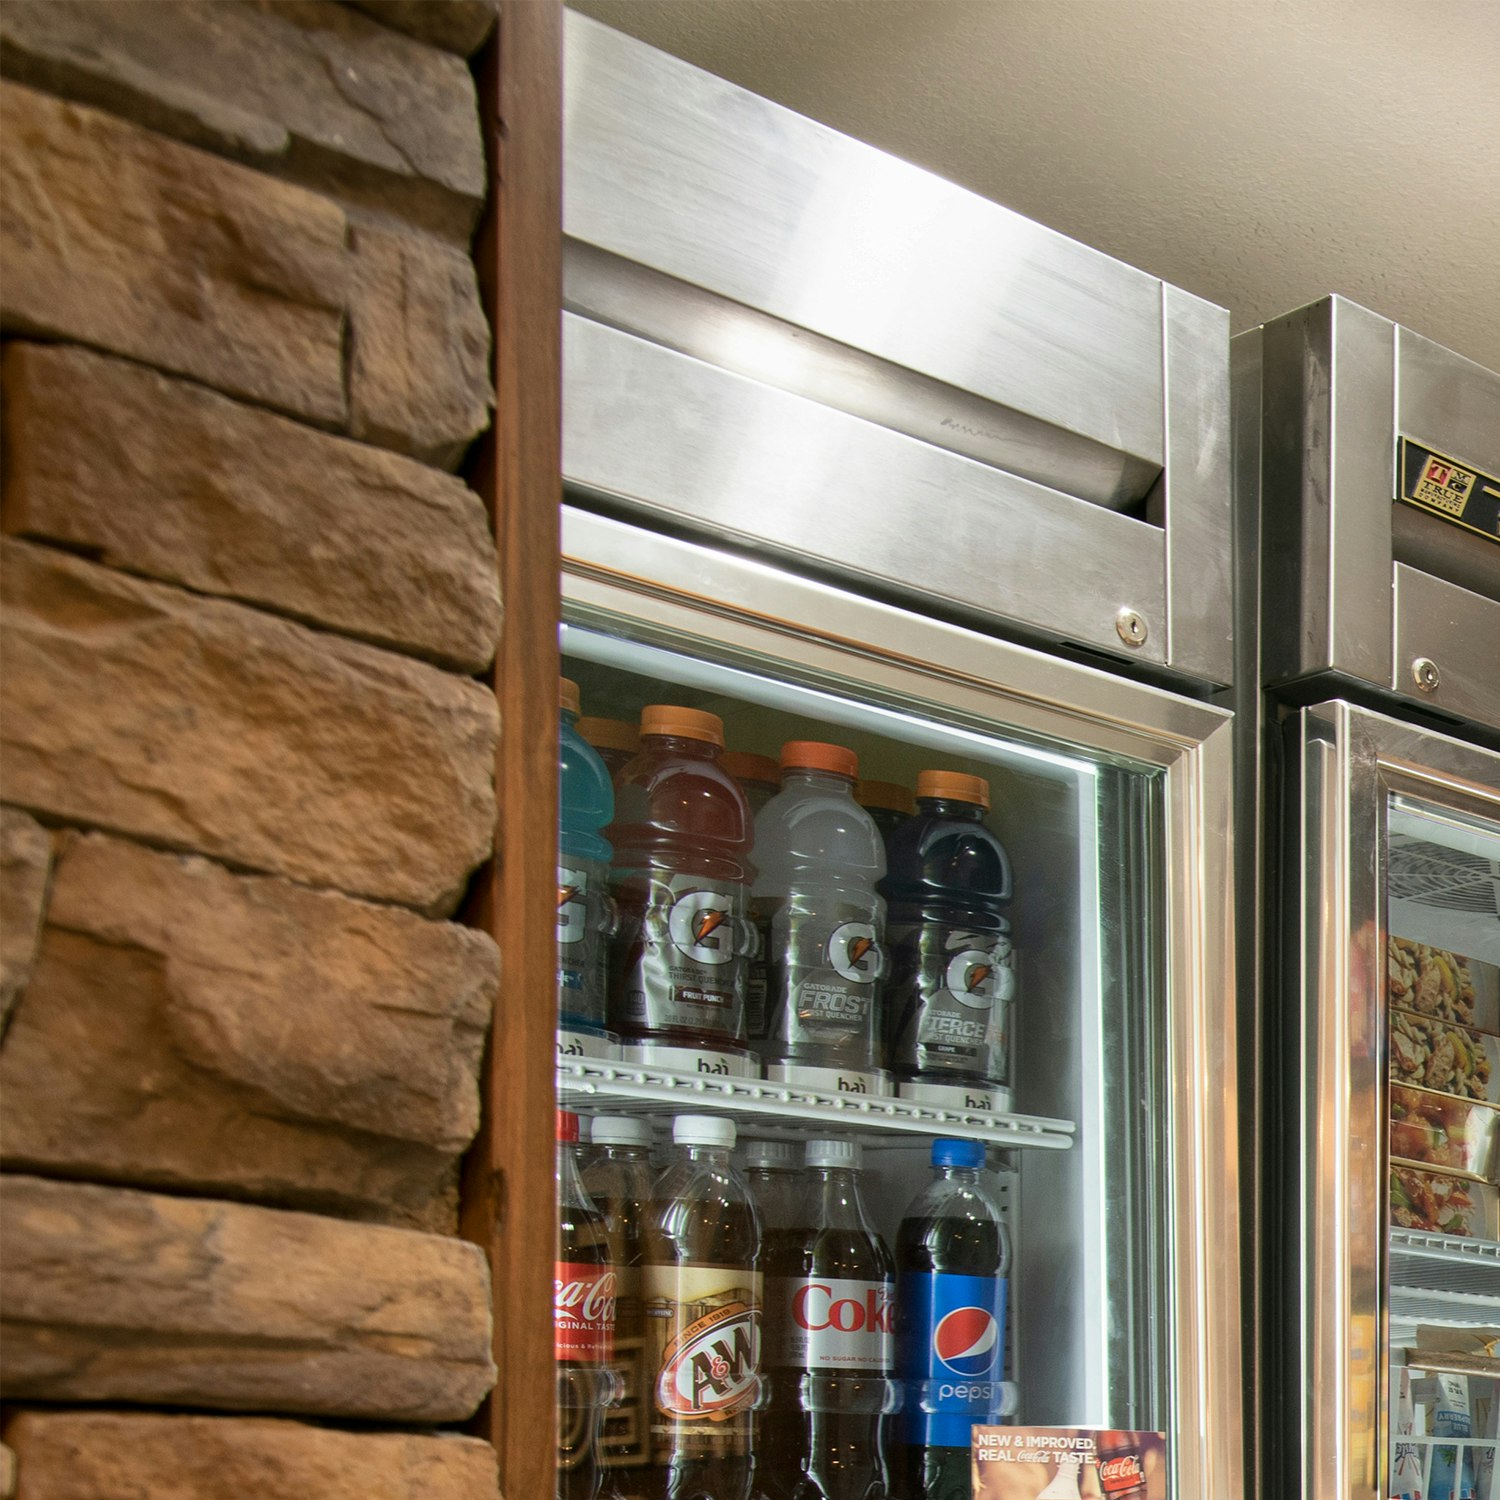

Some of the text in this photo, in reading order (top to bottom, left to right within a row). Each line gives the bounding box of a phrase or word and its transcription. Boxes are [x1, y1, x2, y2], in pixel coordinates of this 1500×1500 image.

[1423, 481, 1464, 504] TRUE
[683, 991, 702, 1001] FRUIT
[804, 982, 847, 994] GATORADE
[799, 990, 870, 1015] FROST
[937, 1045, 957, 1053] GRAPE
[792, 1284, 896, 1334] Coke
[673, 1308, 732, 1349] SINCE 1919
[690, 1315, 761, 1410] A&W
[938, 1383, 995, 1404] pepsi
[978, 1434, 1097, 1451] NEW & IMPROVED.
[978, 1449, 1098, 1465] REAL TASTE.
